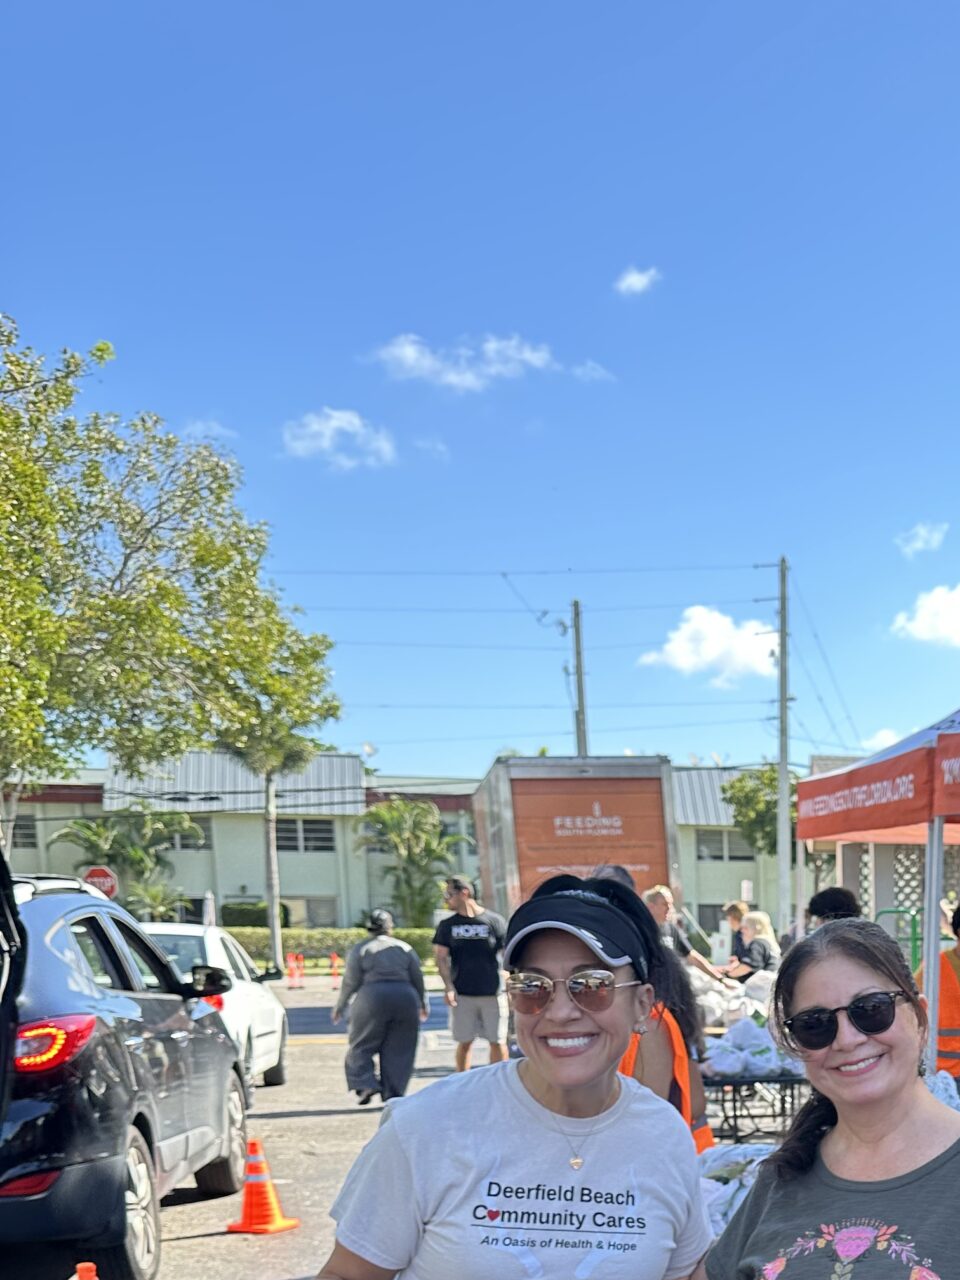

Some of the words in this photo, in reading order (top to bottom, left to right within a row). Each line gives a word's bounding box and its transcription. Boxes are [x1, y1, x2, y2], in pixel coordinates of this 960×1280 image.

[553, 815, 623, 829] FEEDING
[487, 1181, 574, 1201] Deerfield
[580, 1187, 635, 1206] Beach
[472, 1204, 586, 1229] Cmmunity
[592, 1211, 646, 1229] Cares
[481, 1235, 499, 1246] An
[502, 1236, 536, 1248] Oasis
[540, 1237, 551, 1248] of
[555, 1239, 592, 1249] Health
[595, 1240, 604, 1250] &
[607, 1241, 637, 1253] Hope
